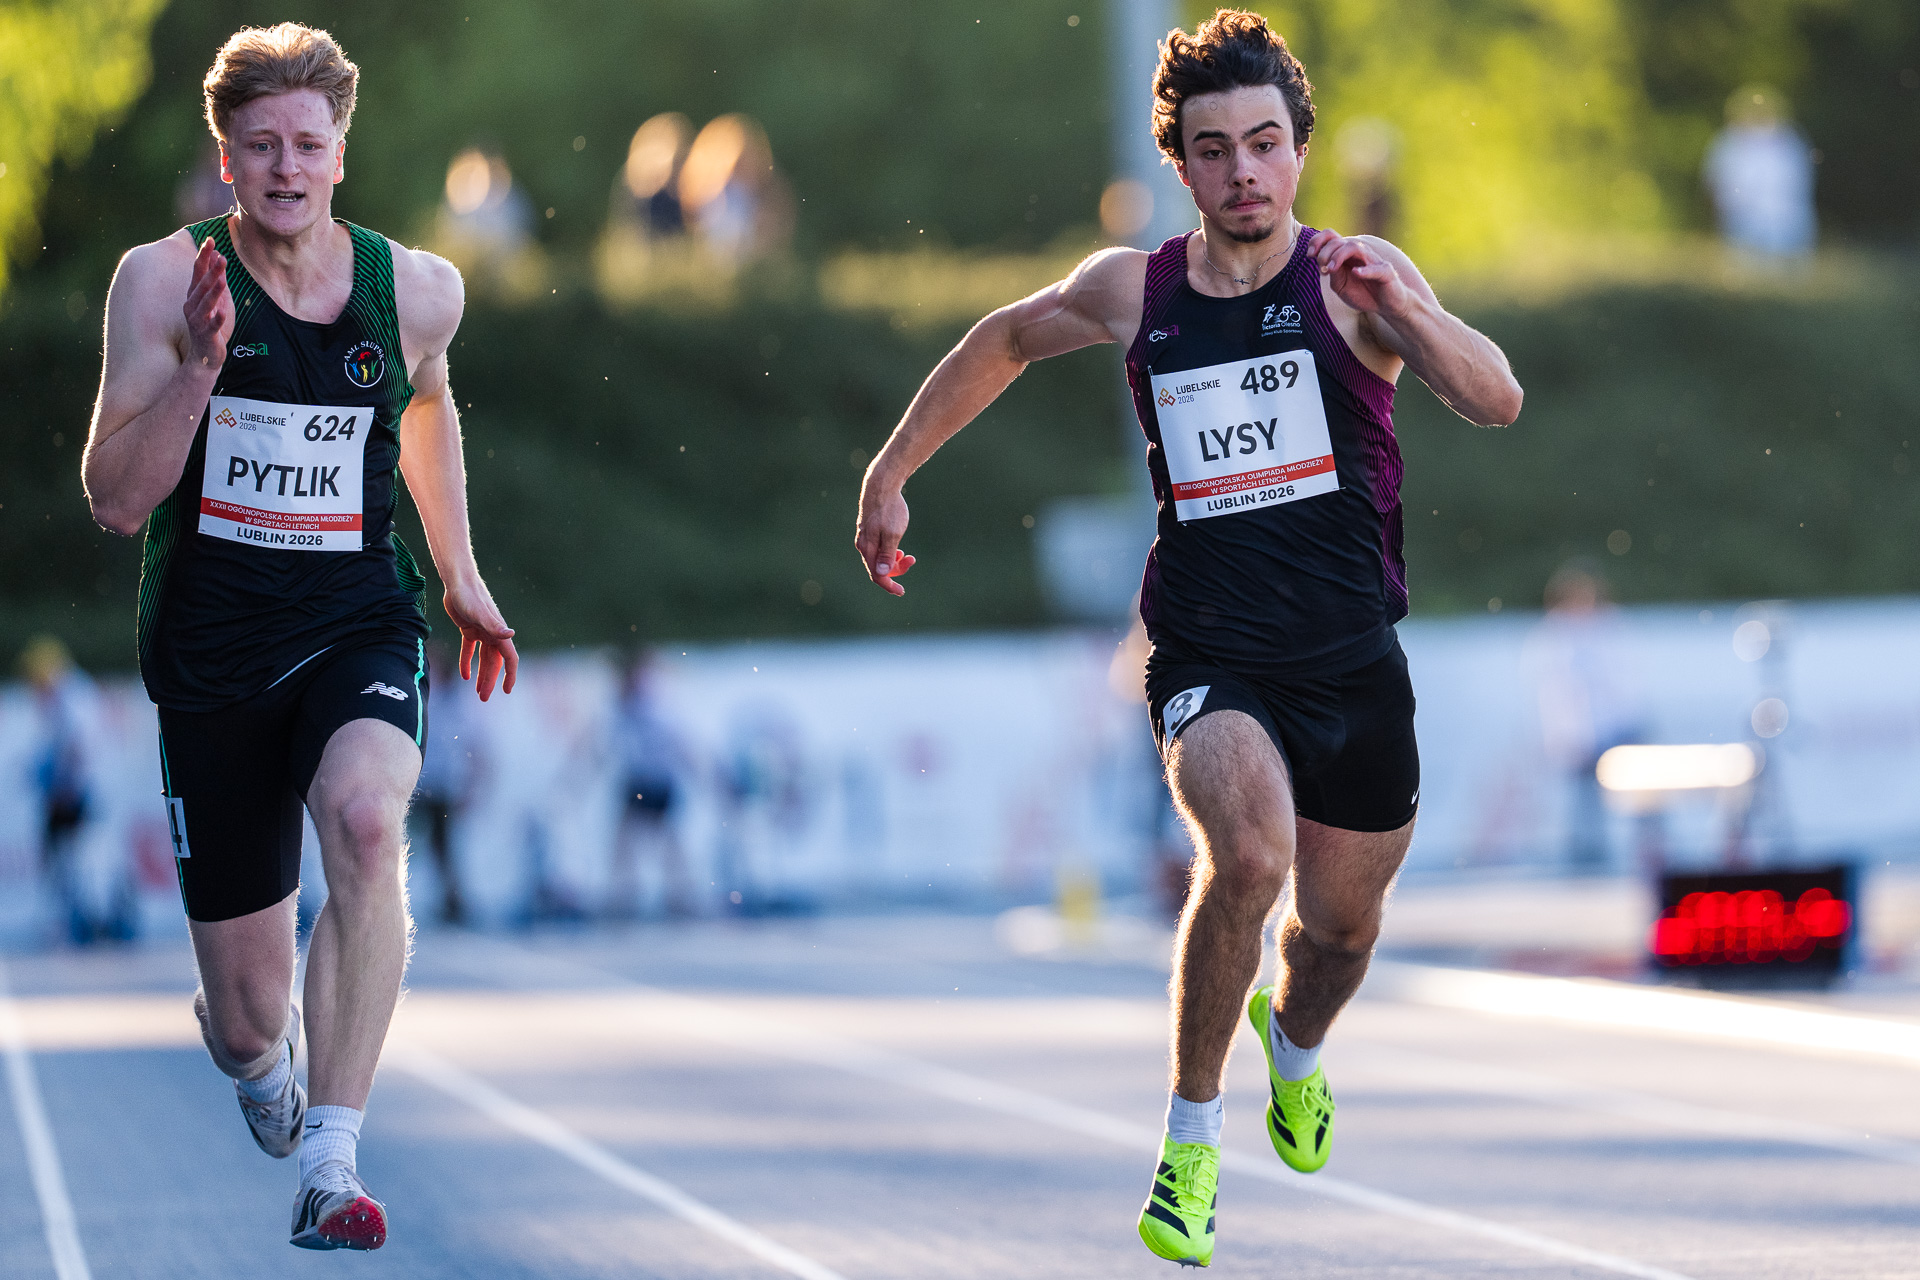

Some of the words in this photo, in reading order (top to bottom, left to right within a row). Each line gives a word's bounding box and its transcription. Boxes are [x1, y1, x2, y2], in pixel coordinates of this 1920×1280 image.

[1175, 378, 1221, 395] LUBELSKIE
[1239, 360, 1300, 395] 489
[1177, 394, 1195, 405] 2026
[239, 421, 257, 432] 2026
[240, 411, 287, 427] LUBELSKIE
[303, 414, 357, 442] 624
[1198, 417, 1278, 463] LYSY
[226, 455, 342, 497] PYTLIK
[1191, 474, 1247, 490] OGÓLNOPOLSKA
[1247, 467, 1286, 480] OLIMPIADA
[1286, 458, 1325, 473] MŁODZIEŻY
[1210, 487, 1219, 495] W
[1219, 481, 1258, 494] SPORTACH
[1258, 474, 1288, 487] LETNICH
[1206, 493, 1257, 512] LUBLIN
[1258, 484, 1296, 502] 2026
[209, 500, 227, 510] XXXII
[227, 505, 283, 521] OGÓLNOPOLSKA
[283, 514, 320, 523] OLIMPIADA
[320, 514, 354, 523] MŁODZIEŻY
[253, 517, 292, 529] SPORTACH
[292, 522, 320, 530] LETNICH
[236, 526, 286, 545] LUBLIN
[288, 533, 324, 546] 2026
[1170, 692, 1194, 732] 3
